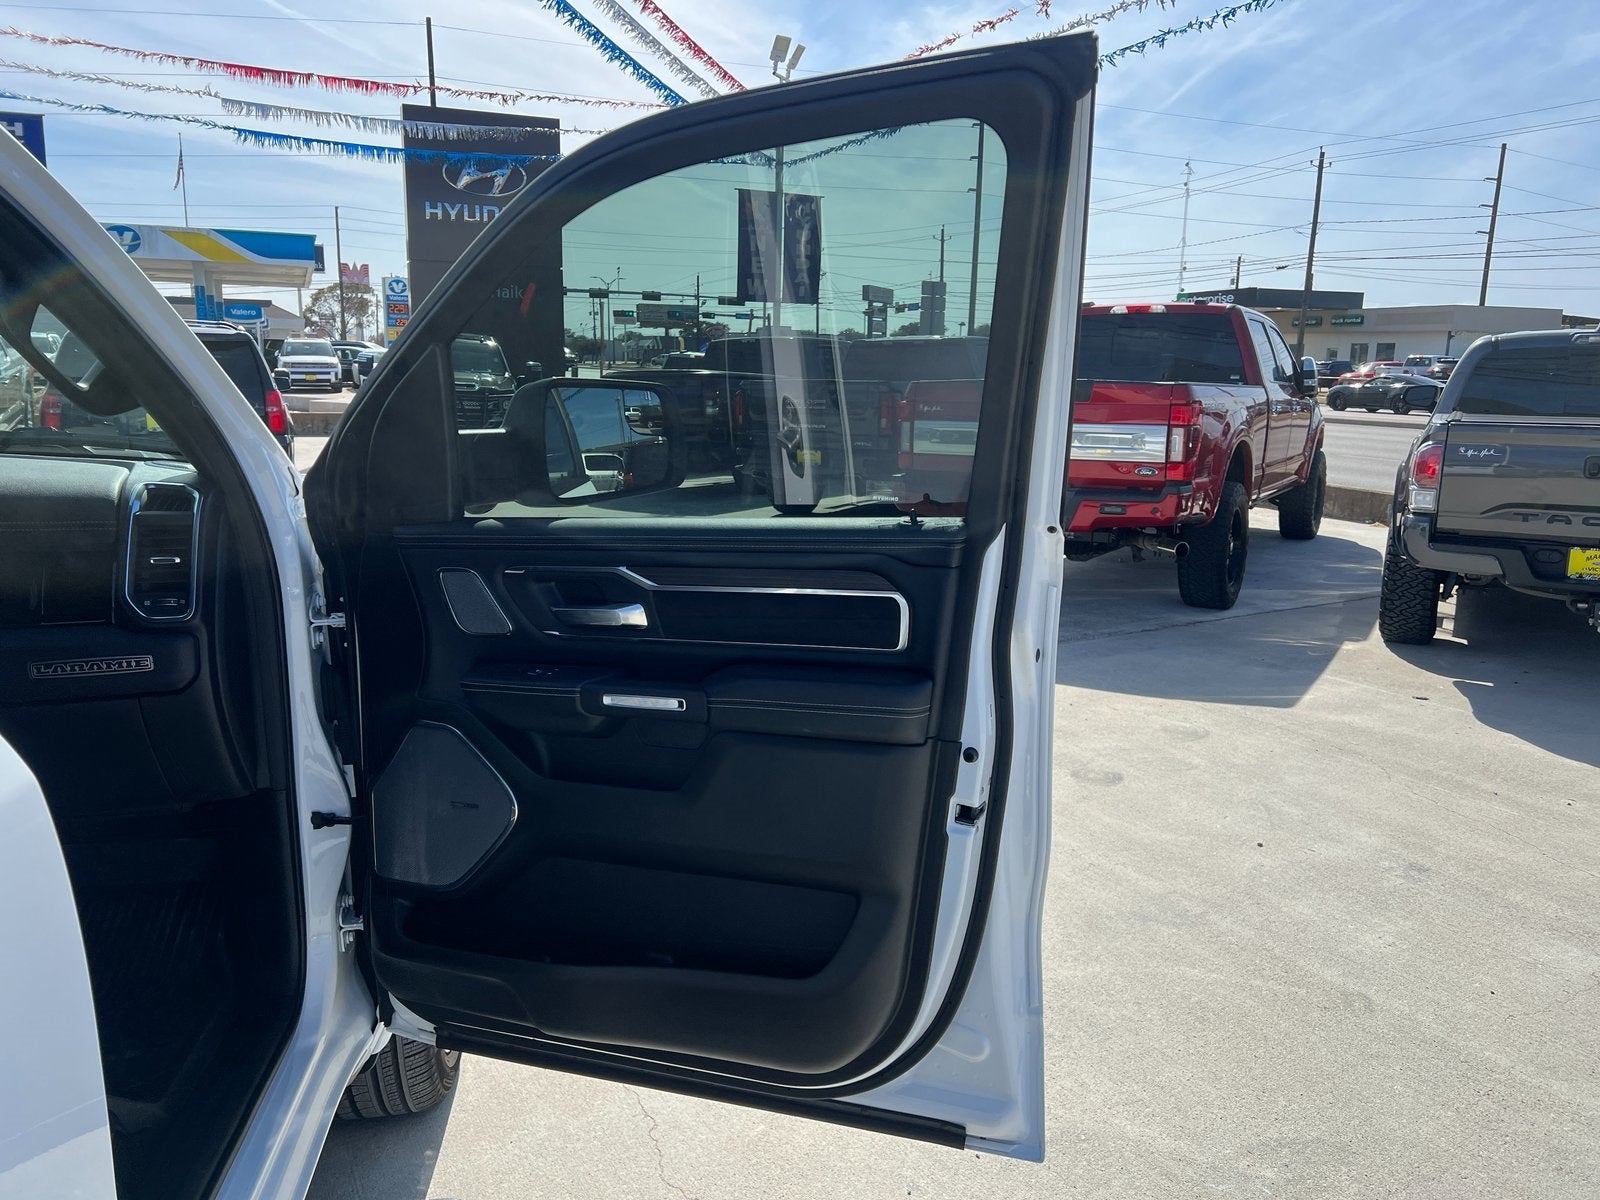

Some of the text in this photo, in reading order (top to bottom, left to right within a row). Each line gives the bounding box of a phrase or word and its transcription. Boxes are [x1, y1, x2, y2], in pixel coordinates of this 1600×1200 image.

[425, 201, 504, 222] HYUN
[230, 308, 257, 316] Valero
[32, 658, 151, 676] LARAMIE
